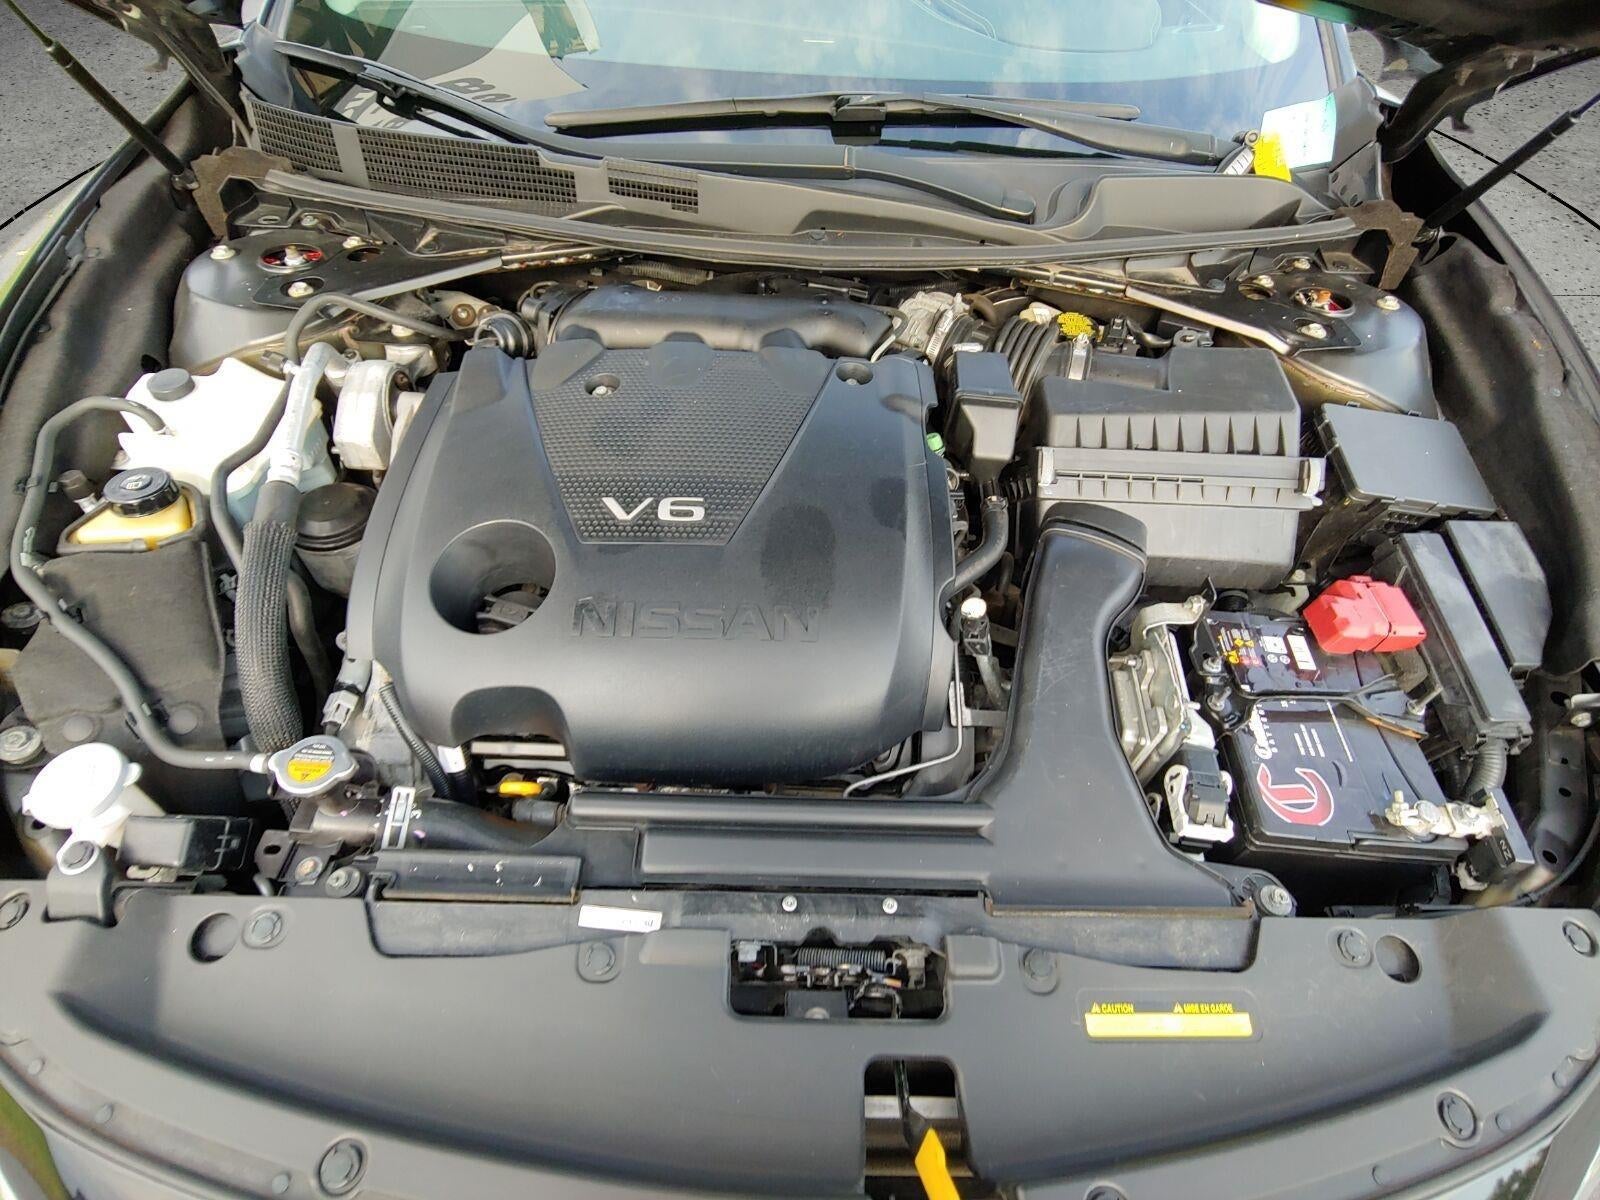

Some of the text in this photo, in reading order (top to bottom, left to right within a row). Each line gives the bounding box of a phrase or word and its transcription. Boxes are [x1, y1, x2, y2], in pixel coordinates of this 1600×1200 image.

[601, 497, 706, 522] V6
[571, 600, 820, 643] NISSAN
[1101, 1002, 1134, 1014] CAUTION
